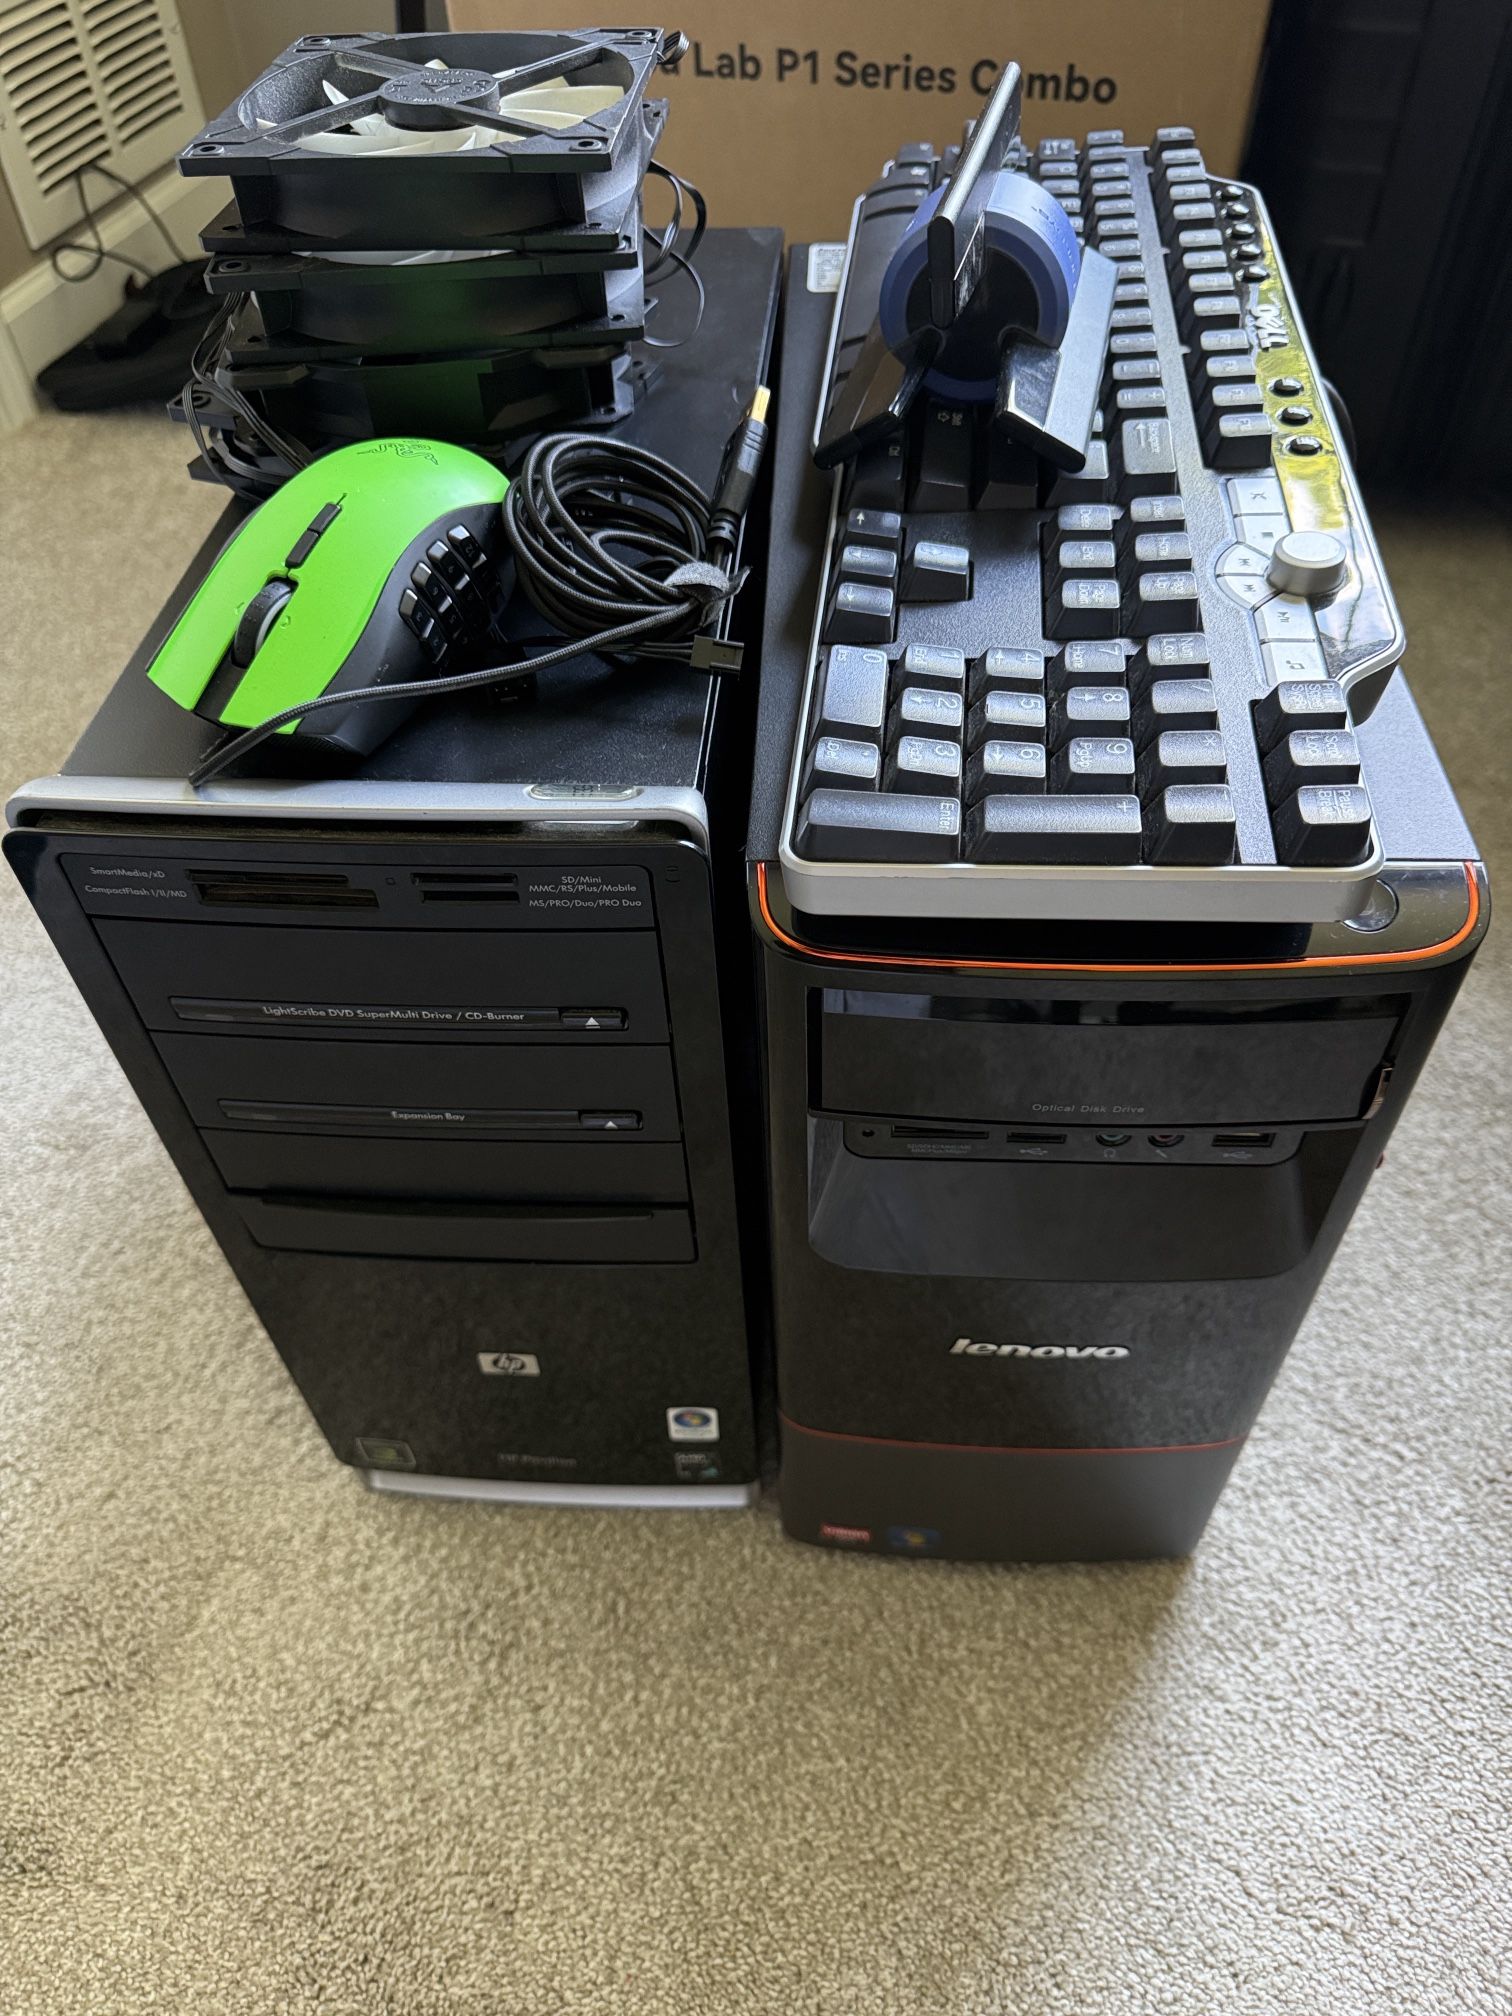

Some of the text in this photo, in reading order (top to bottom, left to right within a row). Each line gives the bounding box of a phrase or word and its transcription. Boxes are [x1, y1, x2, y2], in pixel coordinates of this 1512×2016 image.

[693, 42, 1118, 105] Lab P1 Series Cmbo
[1251, 304, 1289, 349] DELL
[1082, 546, 1094, 561] End
[1092, 584, 1106, 602] Page
[1100, 646, 1119, 656] 7
[1164, 638, 1179, 660] Lock
[1181, 638, 1194, 658] Num
[862, 653, 882, 663] 0
[940, 651, 960, 659] 1
[1021, 652, 1040, 663] 4
[935, 697, 958, 709] 2
[1102, 693, 1123, 702] 8
[1020, 698, 1041, 710] 5
[826, 740, 840, 759] Del
[935, 744, 956, 757] 3
[1020, 748, 1041, 760] 6
[1075, 741, 1093, 768] PgUp
[1106, 743, 1128, 755] 9
[939, 802, 955, 831] Enter
[89, 866, 165, 879] SmartMedia/xD
[561, 876, 602, 885] SD/Mini
[84, 885, 150, 896] CompactFlash
[529, 884, 637, 894] MMC/RS/Plus/Mobile
[529, 899, 642, 909] MS/PRO/Duo/PRO Duo
[262, 1006, 326, 1017] LightScribe
[328, 1009, 354, 1018] DVD
[357, 1009, 420, 1020] SuperMulti
[421, 1011, 453, 1020] Drive
[465, 1012, 525, 1021] CD-Burner
[1031, 1103, 1145, 1113] Optical Disk Drive
[391, 1110, 466, 1122] Expansion Bay
[950, 1338, 1130, 1359] lenovo
